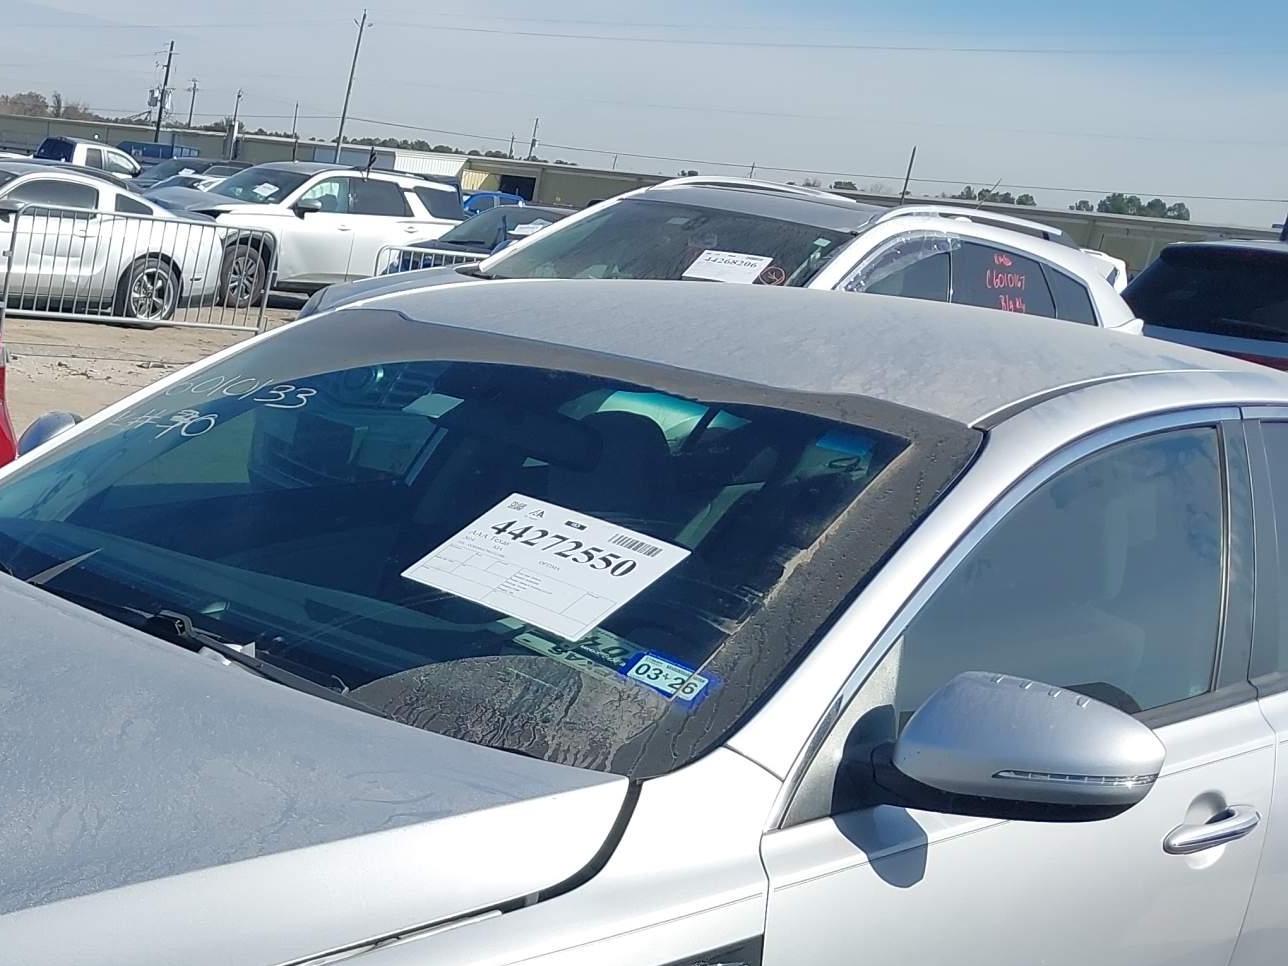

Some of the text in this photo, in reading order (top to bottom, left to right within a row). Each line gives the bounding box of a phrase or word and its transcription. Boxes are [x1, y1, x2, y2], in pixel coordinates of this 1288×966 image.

[491, 520, 637, 577] 44272550
[635, 663, 663, 680] 03
[667, 677, 698, 695] 26
